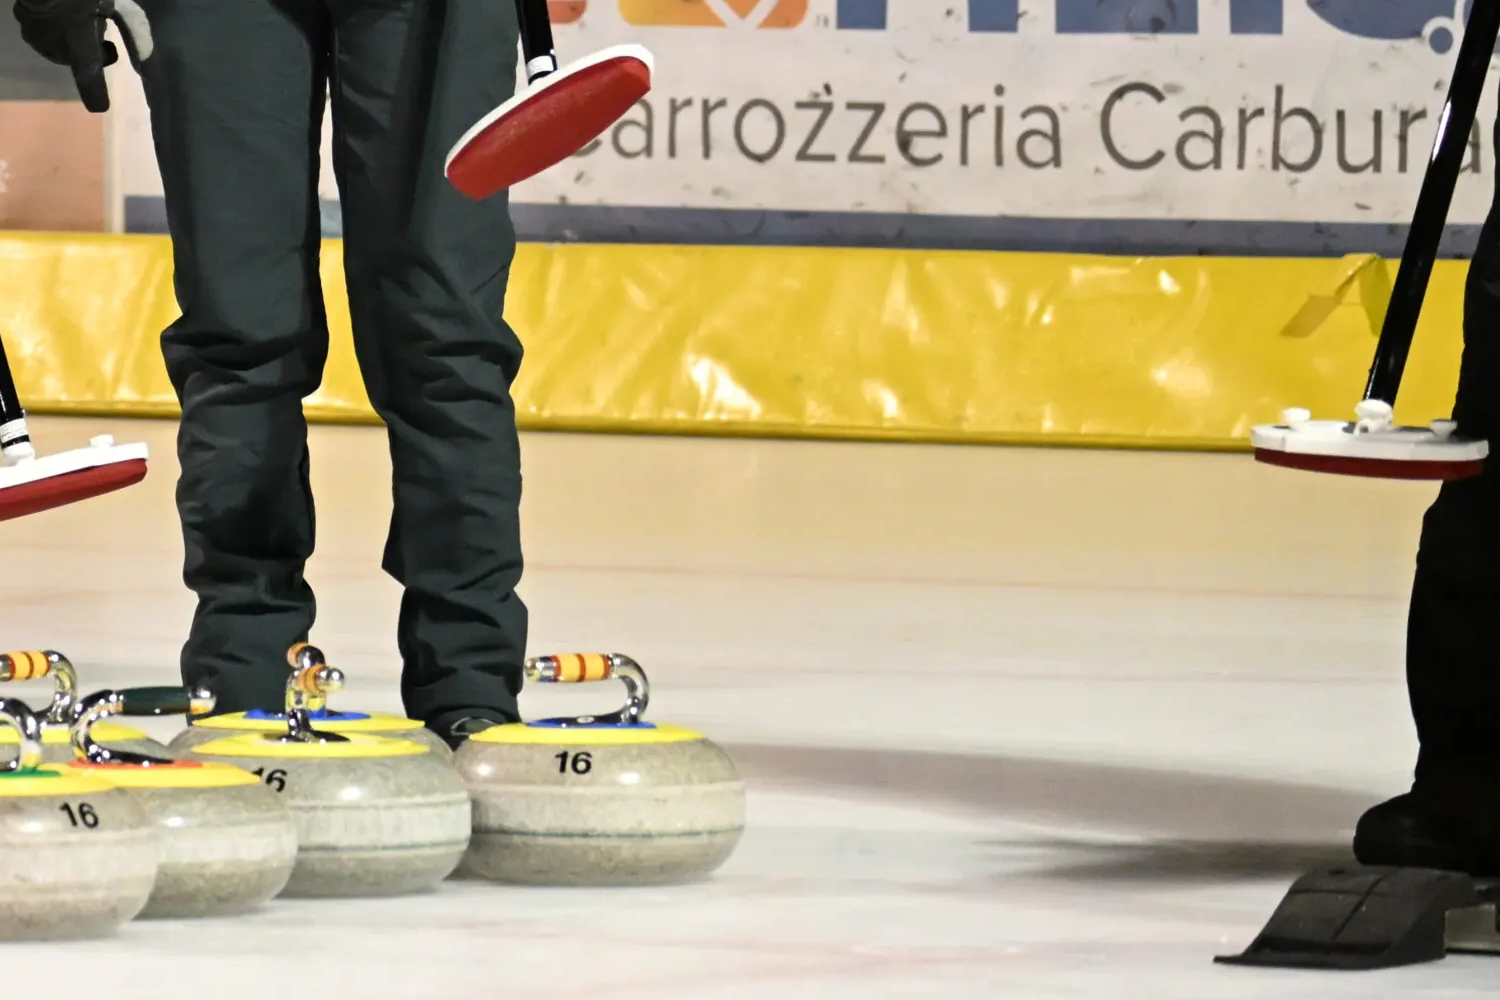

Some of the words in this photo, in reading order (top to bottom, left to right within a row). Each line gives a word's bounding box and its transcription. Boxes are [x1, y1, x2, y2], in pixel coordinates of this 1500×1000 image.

[575, 84, 1064, 170] arrozzeria
[554, 750, 593, 775] 16
[59, 801, 100, 829] 16
